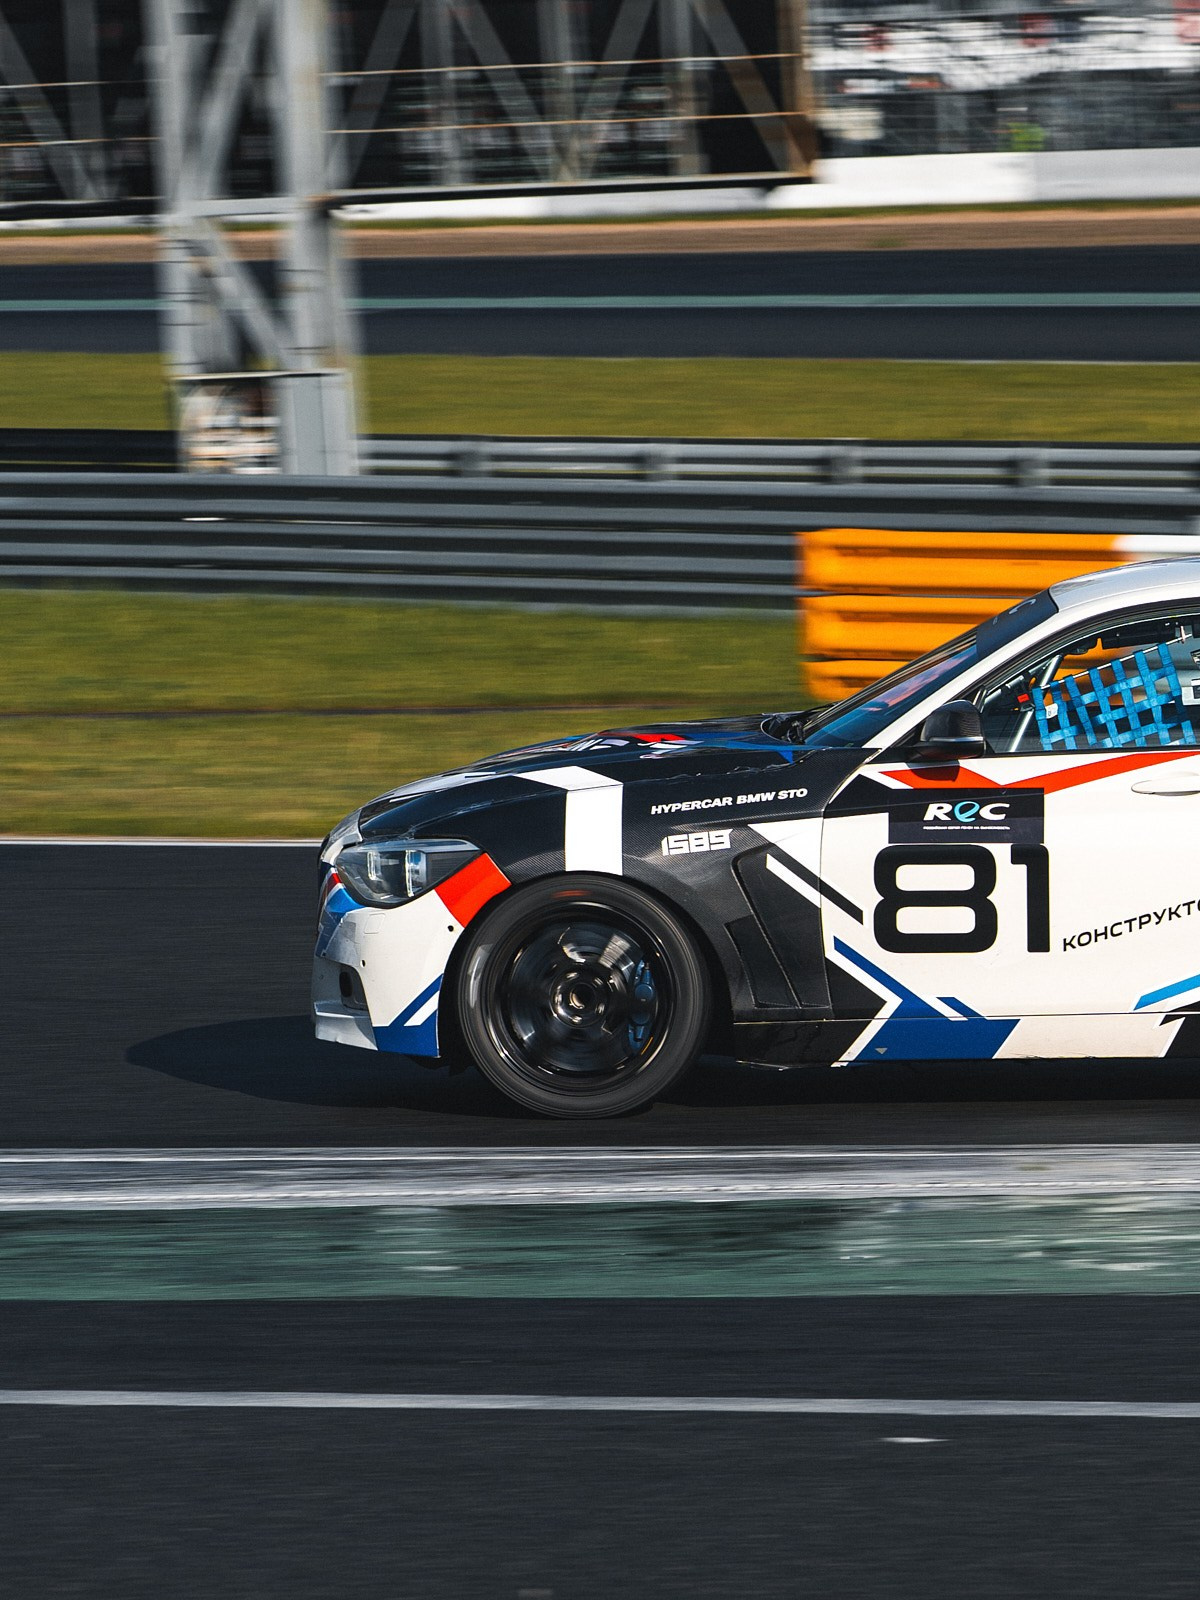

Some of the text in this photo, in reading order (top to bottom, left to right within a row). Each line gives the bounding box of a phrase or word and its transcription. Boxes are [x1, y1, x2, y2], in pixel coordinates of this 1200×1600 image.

[650, 788, 808, 815] HYPERCAR BMW STO
[873, 844, 1050, 954] 81
